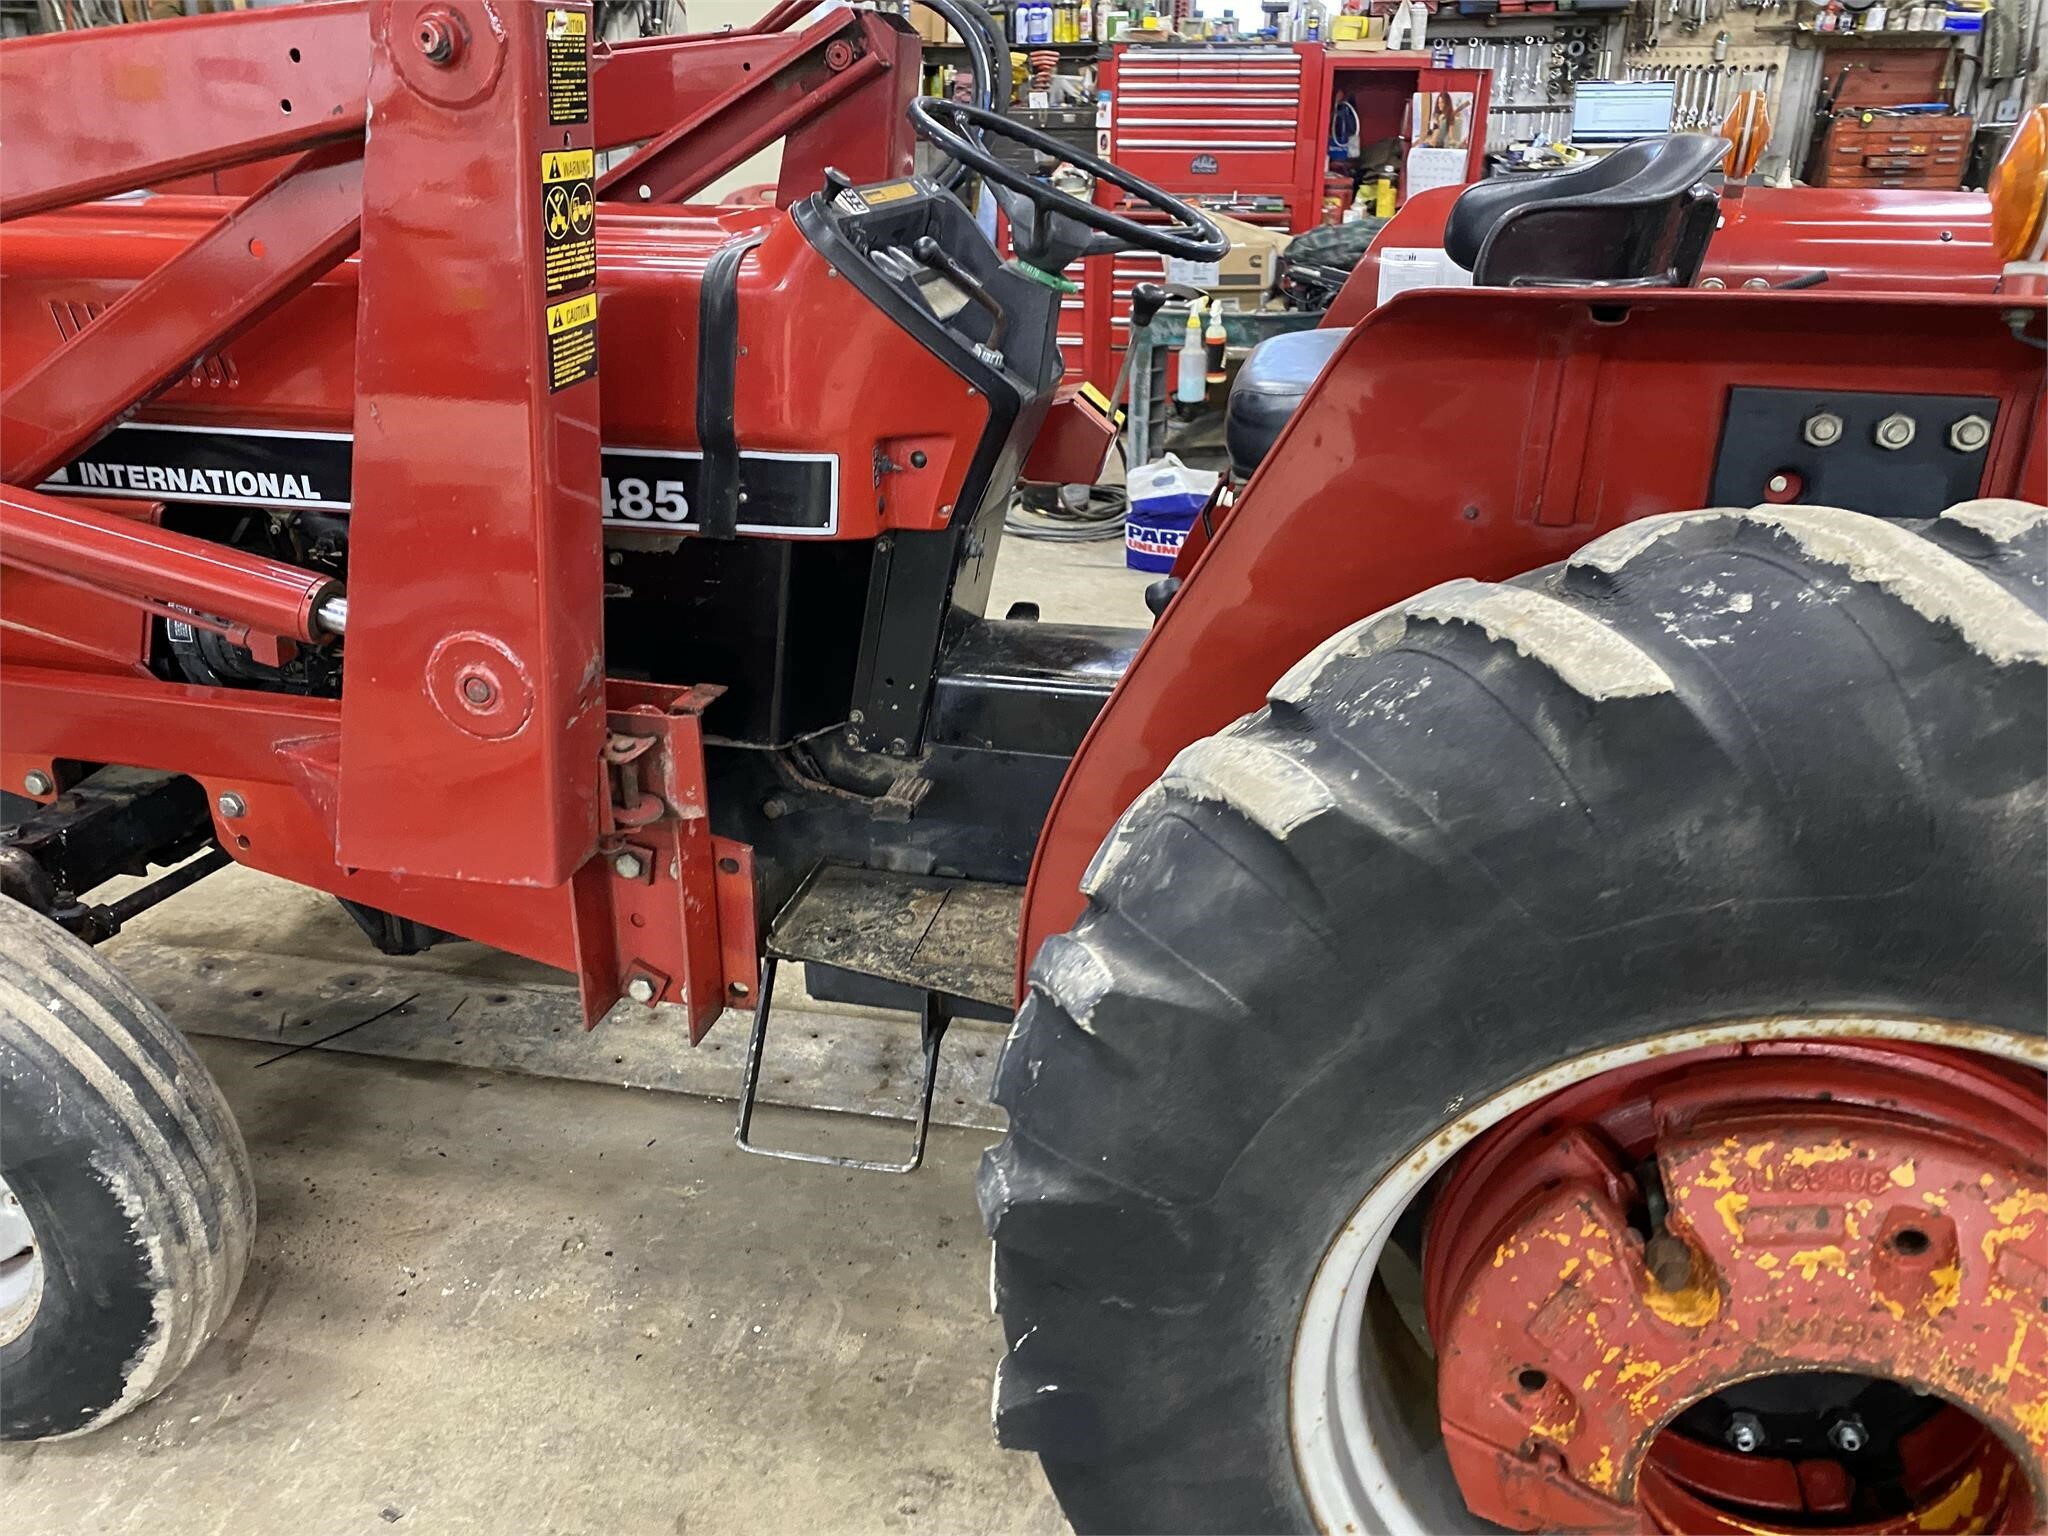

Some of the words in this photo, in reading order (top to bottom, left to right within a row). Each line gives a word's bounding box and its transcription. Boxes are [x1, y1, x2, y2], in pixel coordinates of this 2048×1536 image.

[563, 158, 590, 178] WARNING
[567, 303, 590, 325] CAUTION
[78, 461, 322, 500] INTERNATIONAL
